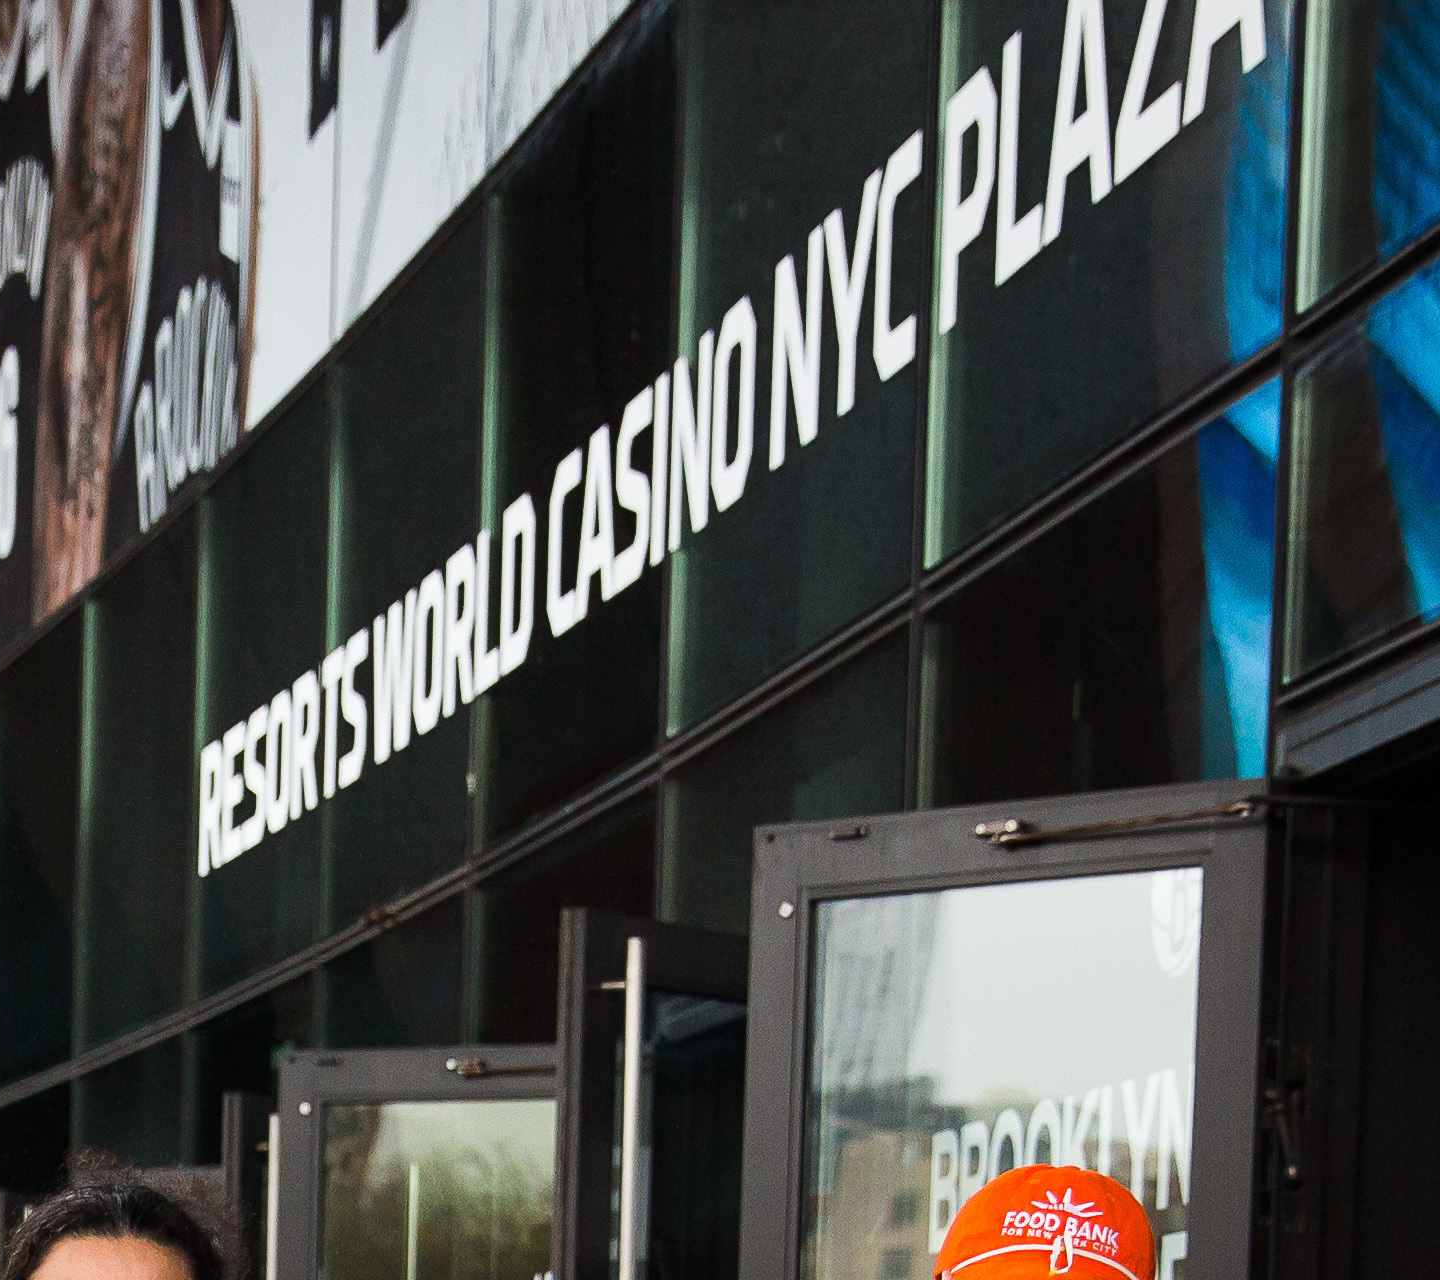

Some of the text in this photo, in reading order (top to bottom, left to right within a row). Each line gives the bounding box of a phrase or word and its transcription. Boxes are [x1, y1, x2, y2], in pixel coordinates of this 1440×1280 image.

[198, 628, 369, 877] RESORTS
[372, 491, 537, 766] WORLD
[547, 295, 757, 638] CASINO
[769, 131, 923, 470] NYC
[938, 0, 1266, 335] PLAZA
[1001, 1228, 1023, 1237] FOR
[1027, 1228, 1053, 1240] NEW
[1092, 1241, 1119, 1257] CITY
[1003, 1211, 1120, 1246] FOOD BANK
